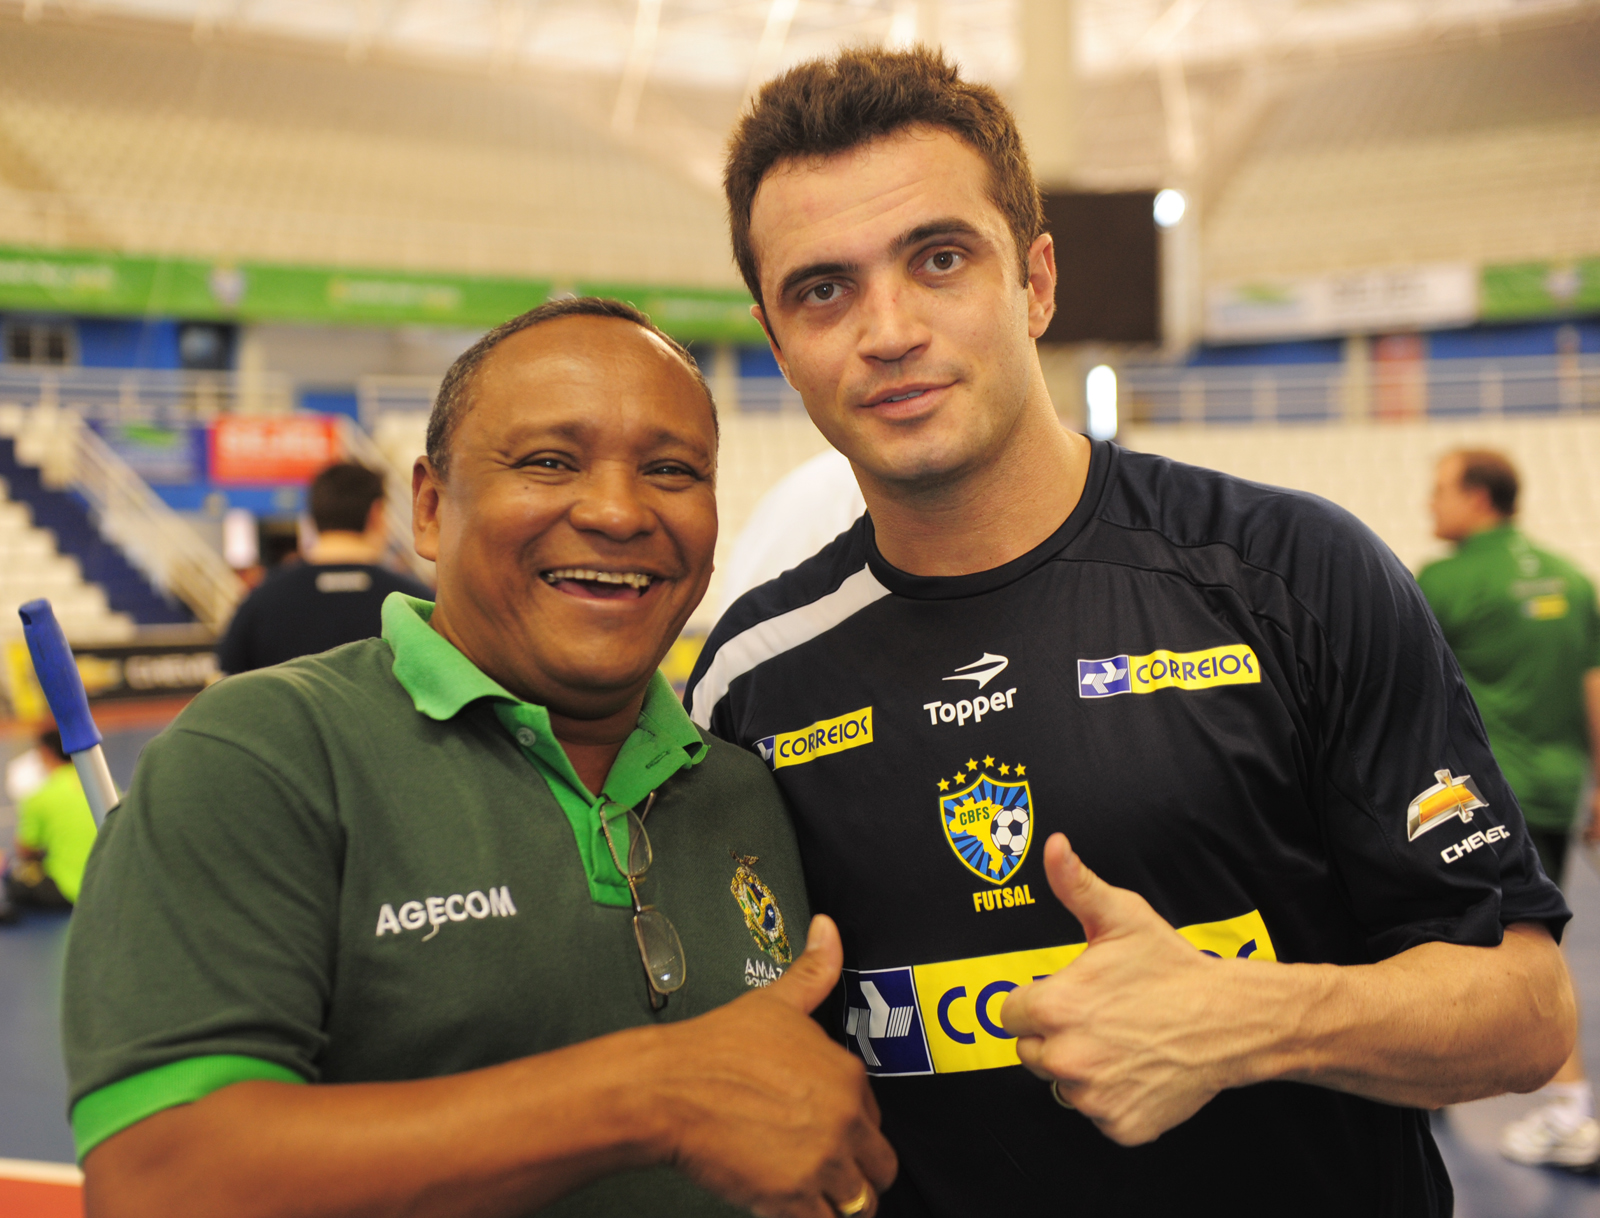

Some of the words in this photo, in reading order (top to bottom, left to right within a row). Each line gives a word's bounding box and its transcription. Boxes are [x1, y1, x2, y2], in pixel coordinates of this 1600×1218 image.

[1136, 653, 1253, 684] CORREIOS
[923, 687, 1017, 726] Topper
[780, 715, 868, 758] CORREIOS
[959, 806, 990, 826] CBFS
[376, 886, 517, 936] AGECOM
[973, 884, 1035, 912] FUTSAL
[745, 957, 785, 981] AMAZ
